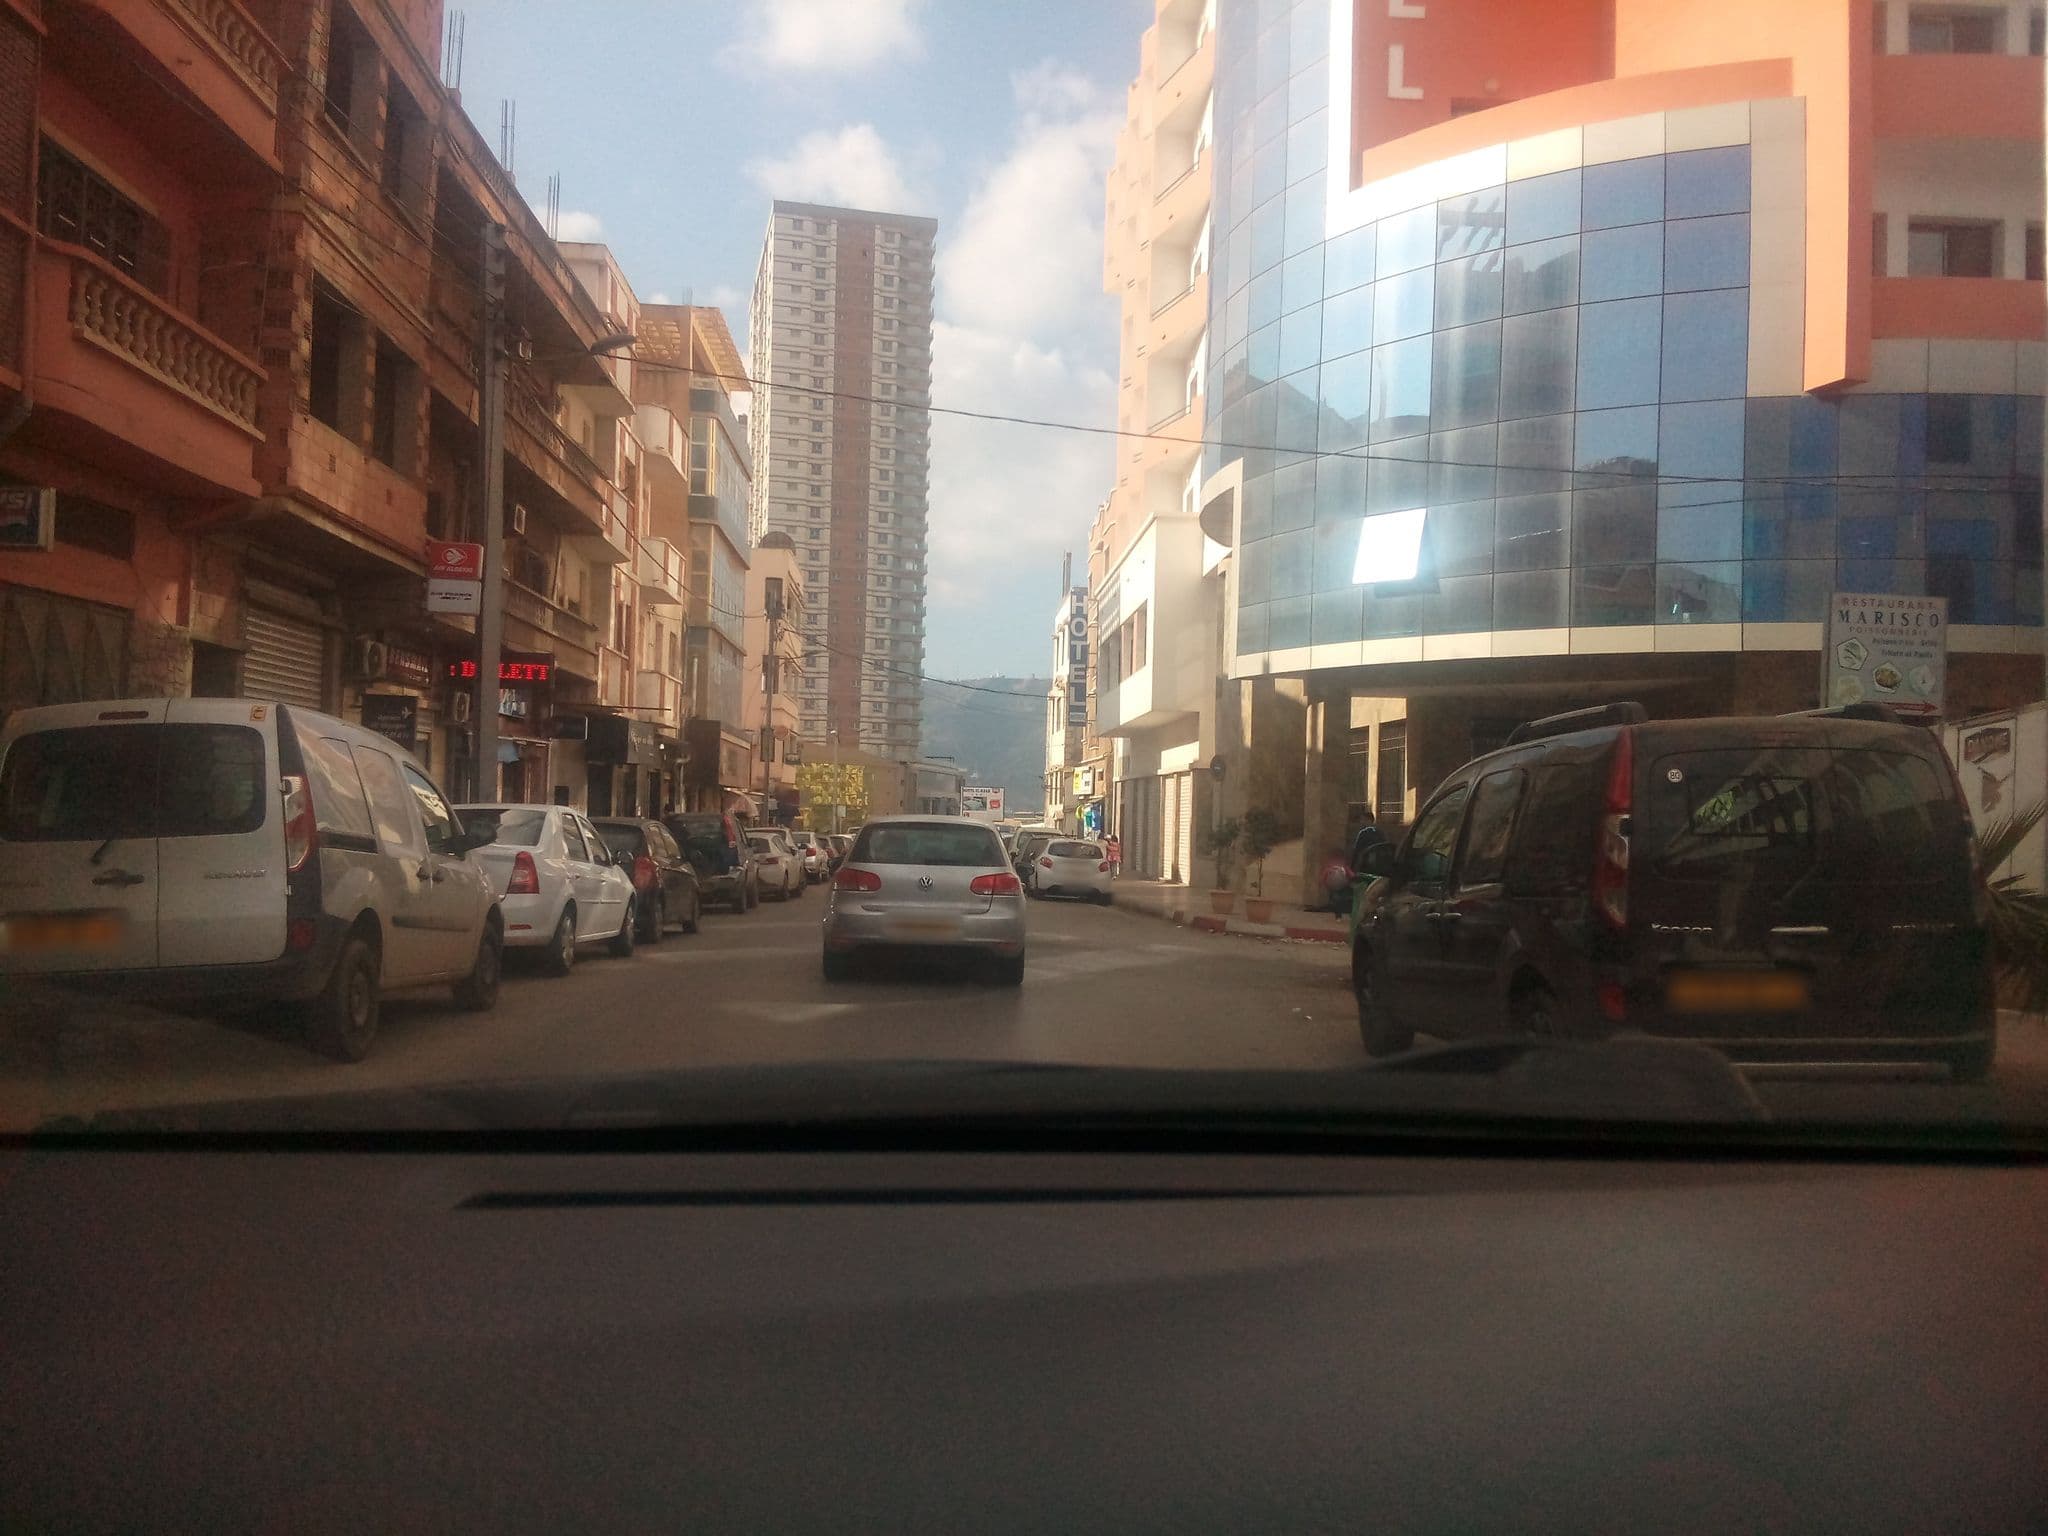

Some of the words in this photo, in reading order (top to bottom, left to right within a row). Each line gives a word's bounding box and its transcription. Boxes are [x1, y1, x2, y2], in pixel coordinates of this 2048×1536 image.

[1841, 597, 1936, 609] RESTAURANT
[1838, 610, 1940, 628] MARISCO
[1069, 594, 1089, 706] HOTEL
